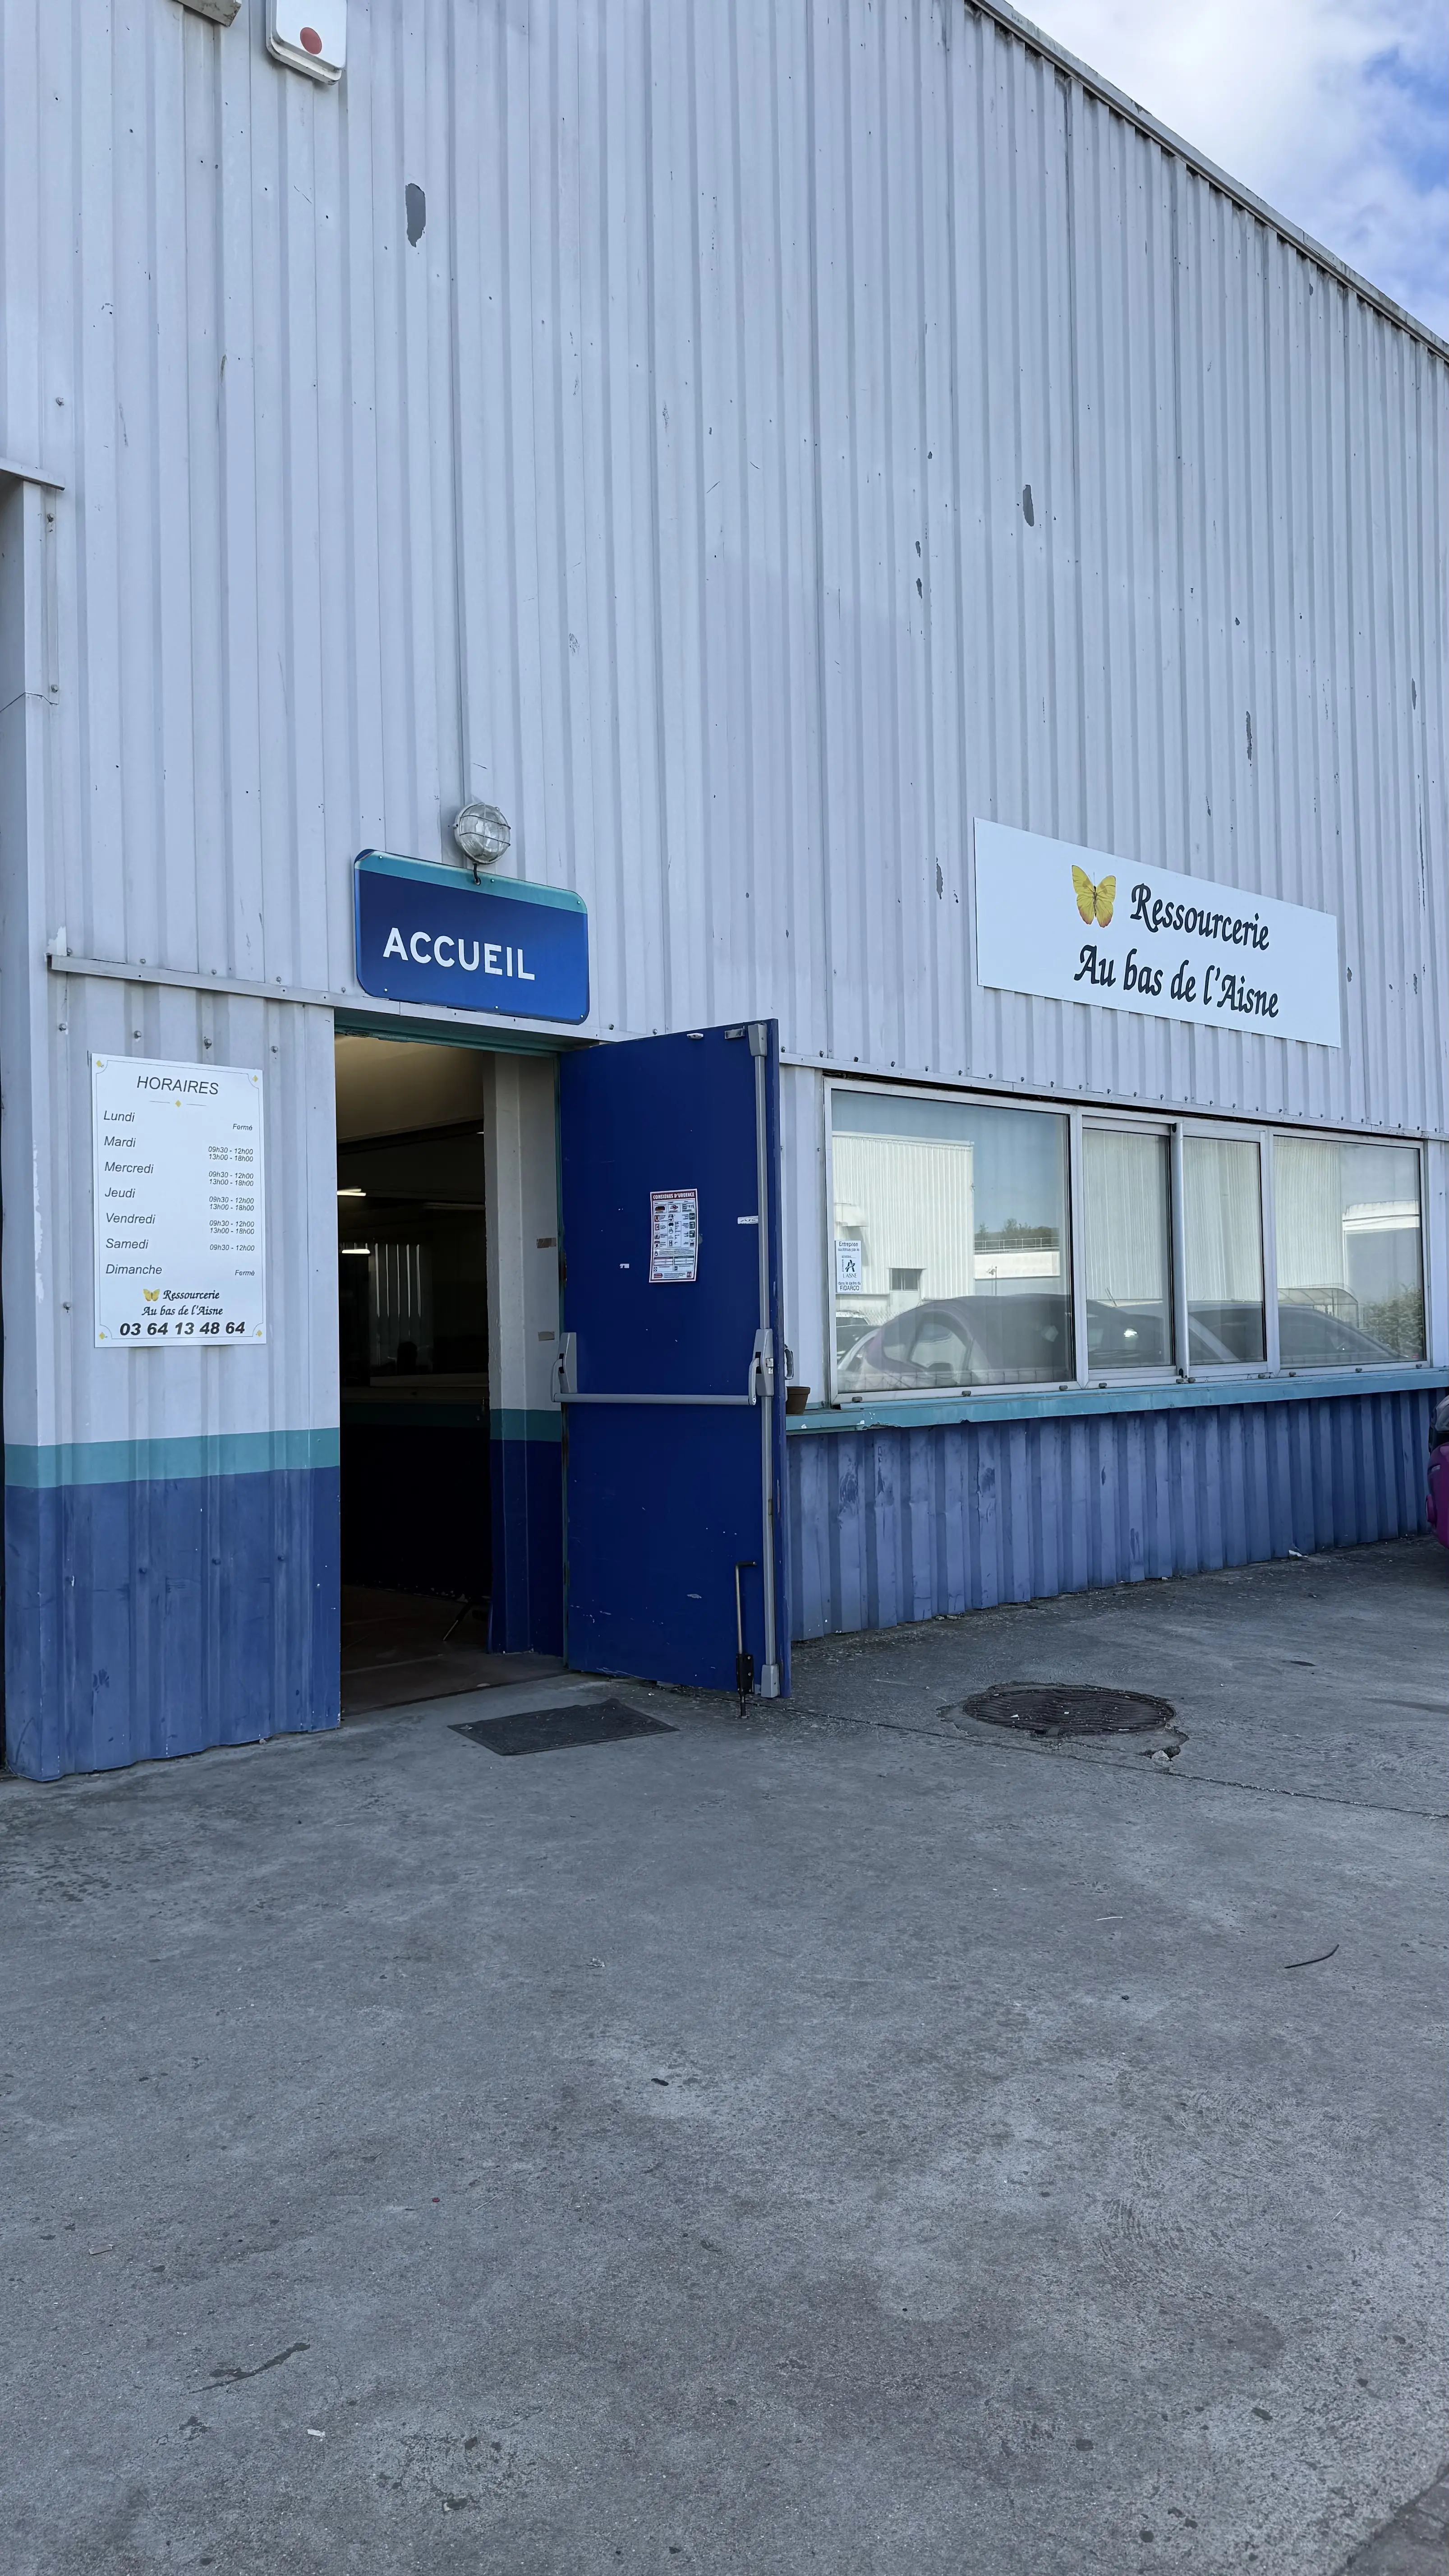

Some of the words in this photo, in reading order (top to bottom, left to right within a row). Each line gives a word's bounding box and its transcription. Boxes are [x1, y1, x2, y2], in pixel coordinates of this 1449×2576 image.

[1130, 883, 1269, 951] Ressourcerie
[383, 927, 535, 980] ACCUEIL
[1074, 945, 1116, 987] Au
[1123, 948, 1164, 996] bas
[1170, 959, 1196, 1002] de
[1203, 965, 1279, 1018] l'Aisne
[137, 1076, 219, 1095] HORAIRES
[103, 1110, 135, 1122] Lundi
[104, 1136, 136, 1148] Mardi
[104, 1161, 154, 1174] Mercredi
[105, 1187, 136, 1198] Jeudi
[106, 1212, 156, 1224] Vendredi
[106, 1238, 149, 1249] Samedi
[106, 1264, 162, 1274] Dimanche
[162, 1290, 220, 1301] Ressourcerie
[141, 1306, 157, 1316] Au
[160, 1305, 175, 1316] bas
[178, 1305, 189, 1316] de
[191, 1305, 223, 1316] l'Aisne
[120, 1323, 141, 1336] 03
[147, 1322, 168, 1335] 64
[175, 1322, 194, 1335] 13
[199, 1322, 220, 1334] 48
[225, 1321, 245, 1334] 64
